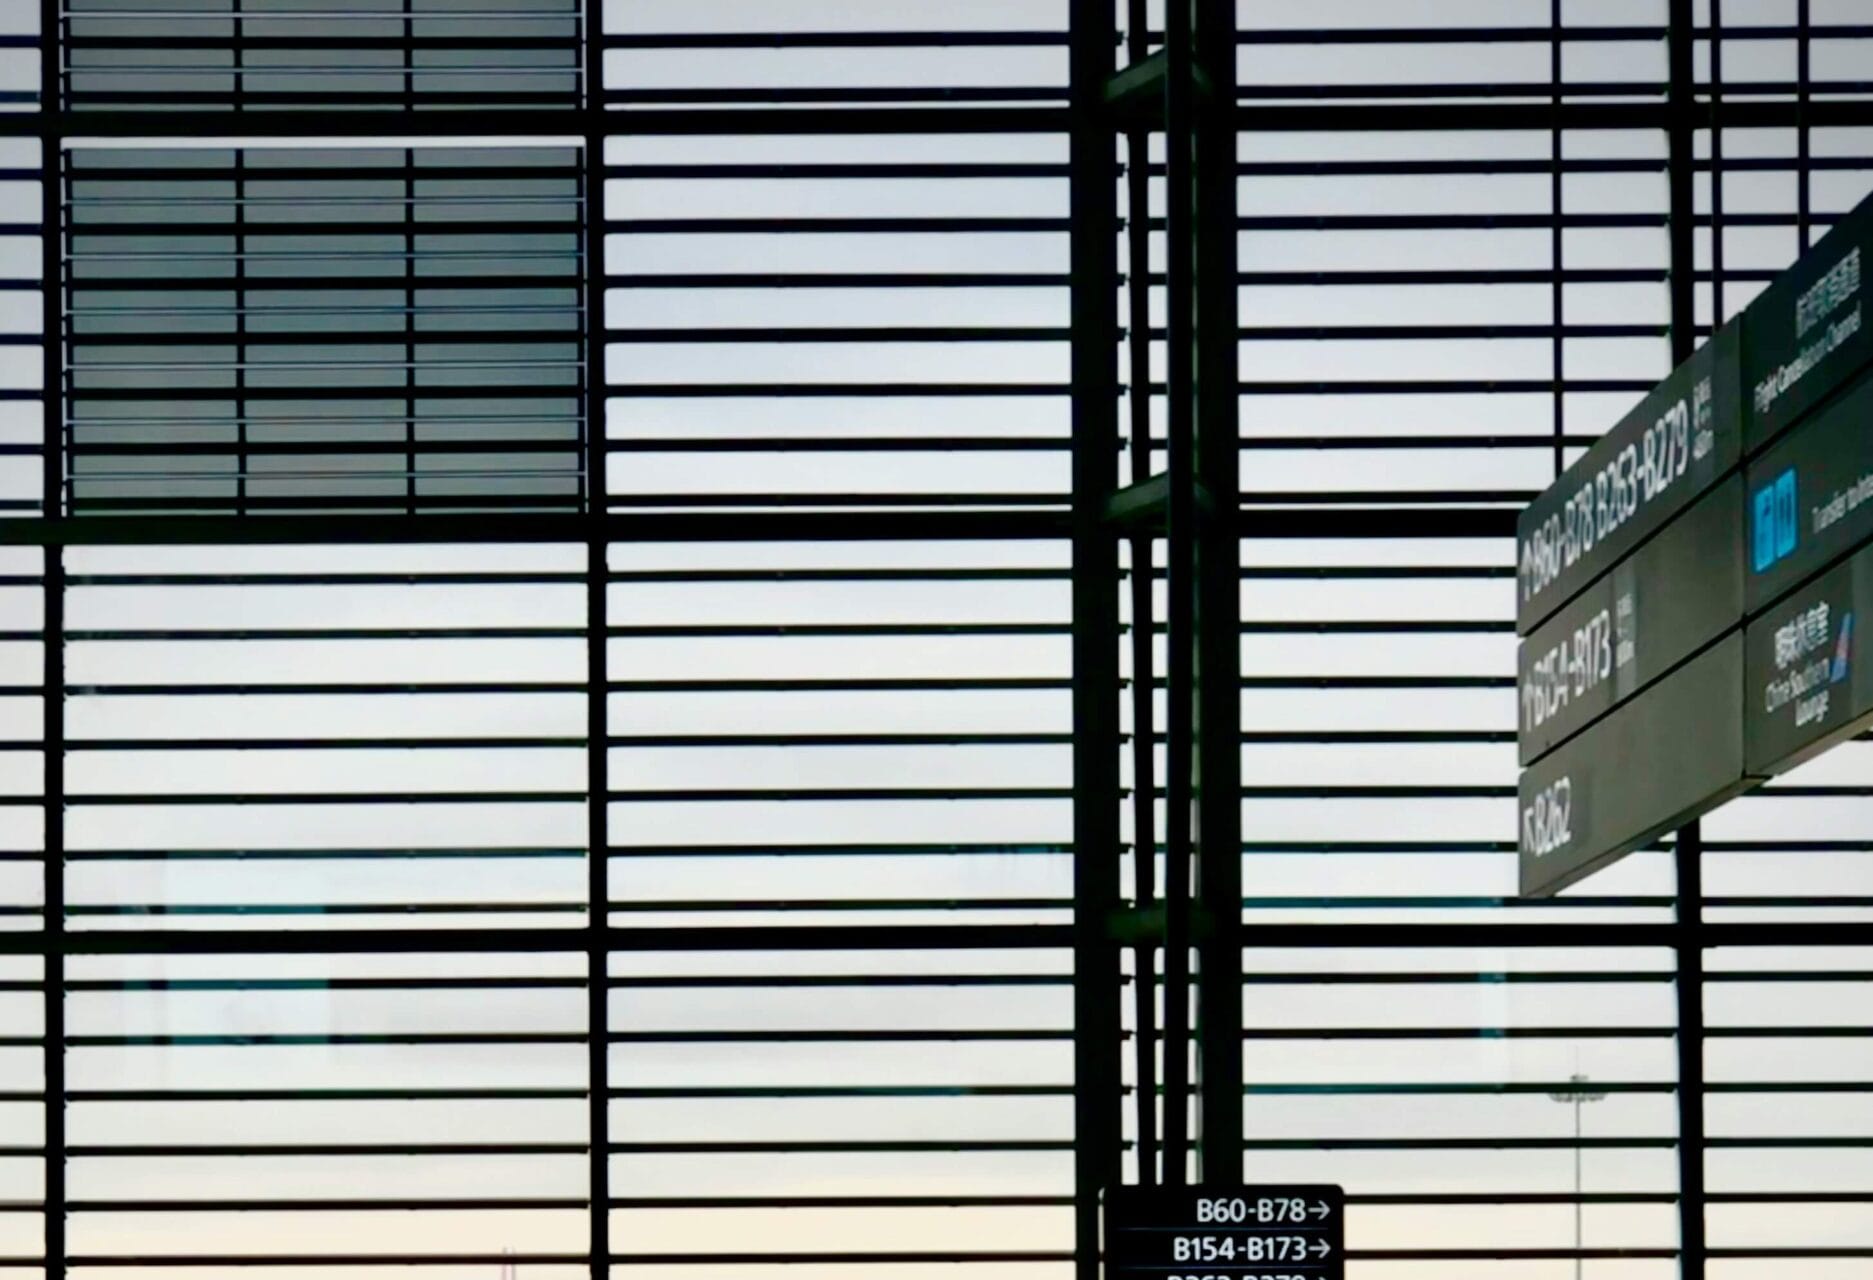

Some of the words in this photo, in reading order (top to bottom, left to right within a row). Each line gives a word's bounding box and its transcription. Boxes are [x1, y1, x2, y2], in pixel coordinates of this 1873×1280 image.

[1533, 482, 1595, 595] B60-B78
[1197, 1198, 1306, 1222] B60-B78
[1173, 1236, 1307, 1261] B154-B173
